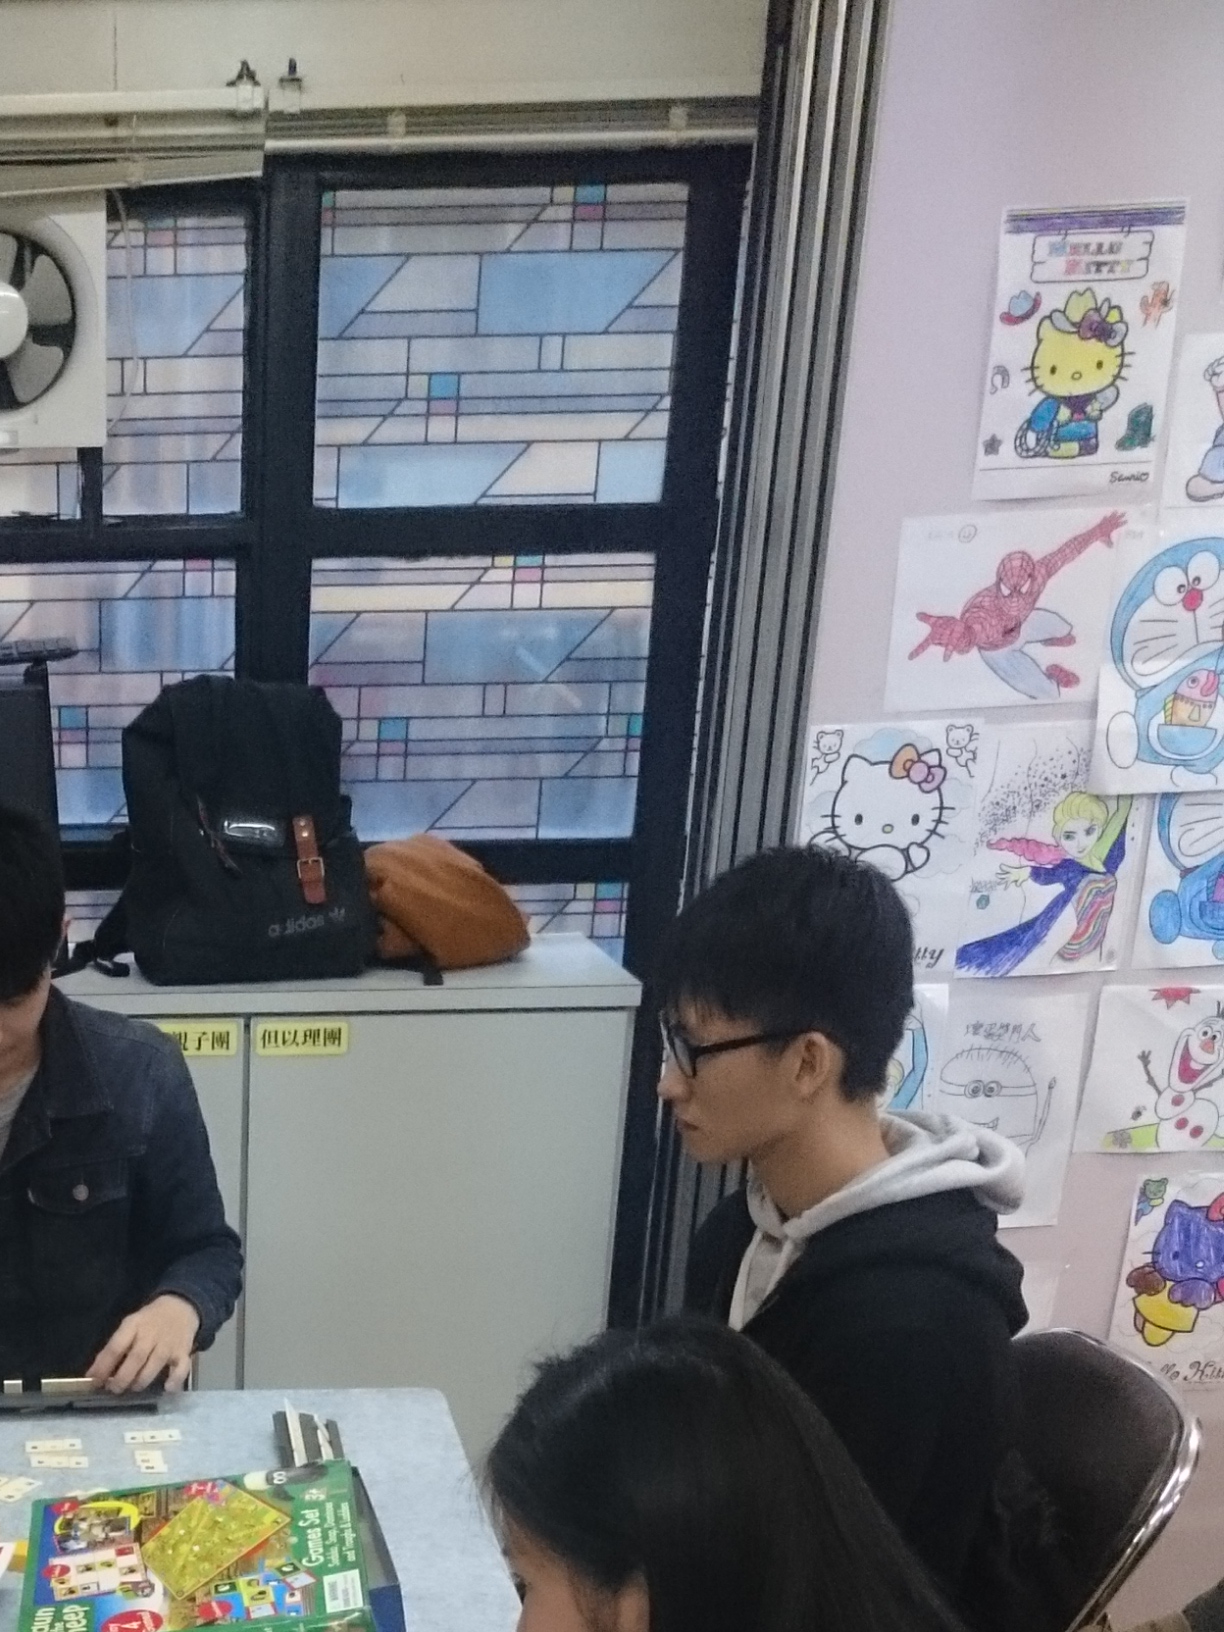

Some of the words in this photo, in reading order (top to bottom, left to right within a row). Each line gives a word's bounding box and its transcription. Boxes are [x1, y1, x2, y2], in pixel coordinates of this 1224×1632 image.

[1063, 258, 1134, 276] KITTY
[261, 1027, 343, 1049] 但以理團
[298, 1508, 321, 1527] Set
[302, 1528, 325, 1567] Games
[119, 1620, 141, 1630] 4
